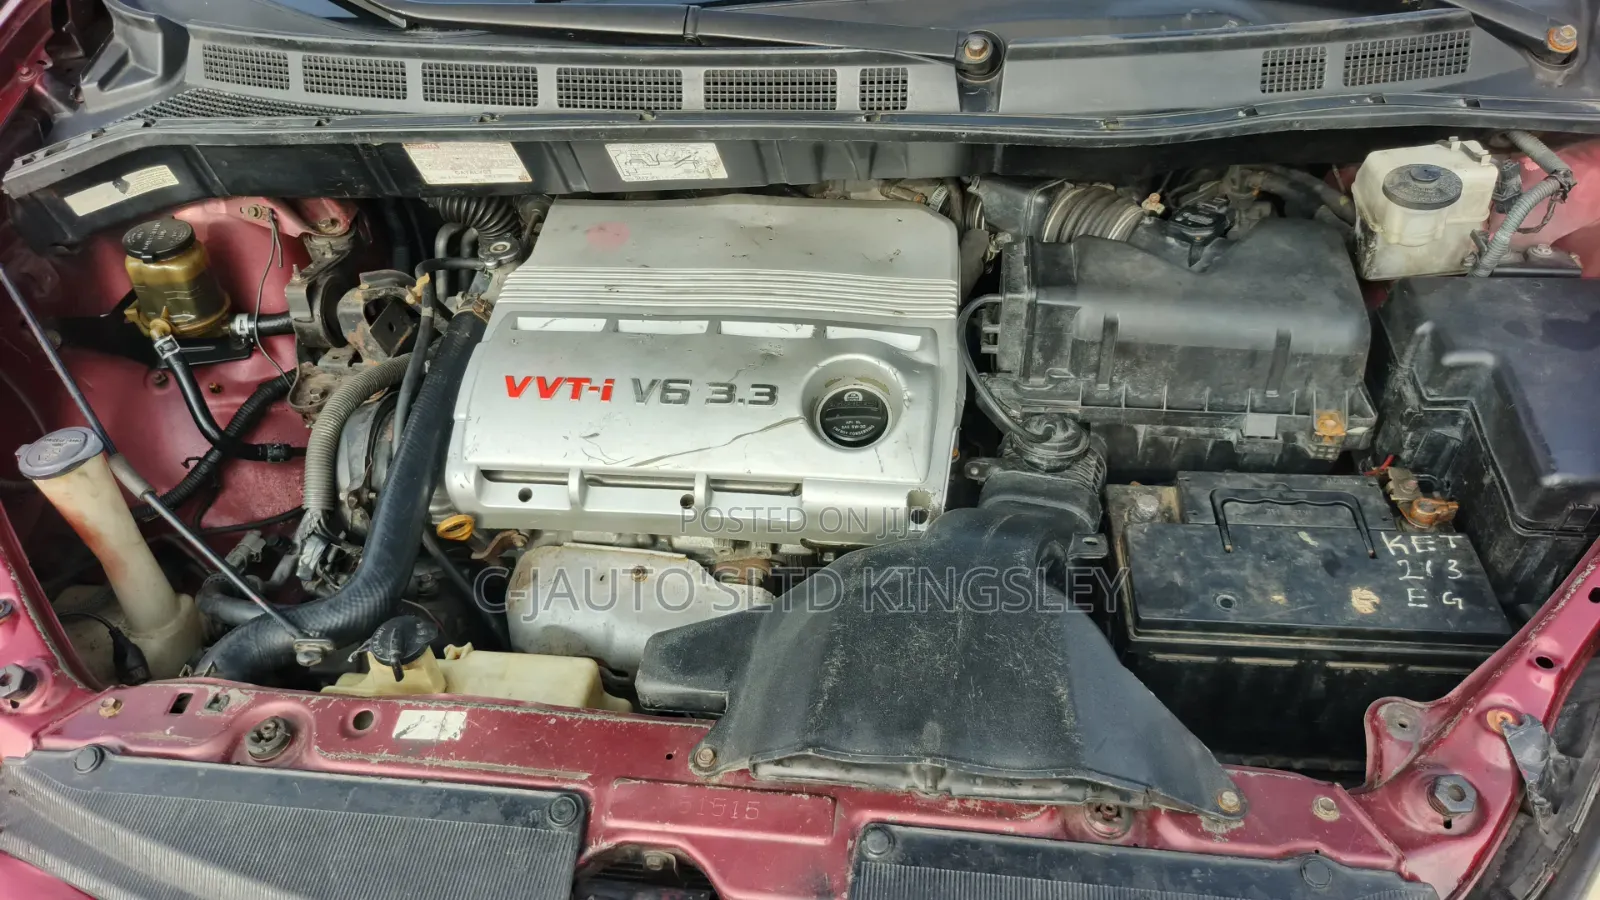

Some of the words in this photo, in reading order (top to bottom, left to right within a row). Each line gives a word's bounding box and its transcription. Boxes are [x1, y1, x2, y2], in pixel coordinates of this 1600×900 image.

[630, 378, 692, 405] V6
[705, 382, 779, 408] 3.3
[1380, 531, 1464, 556] KET
